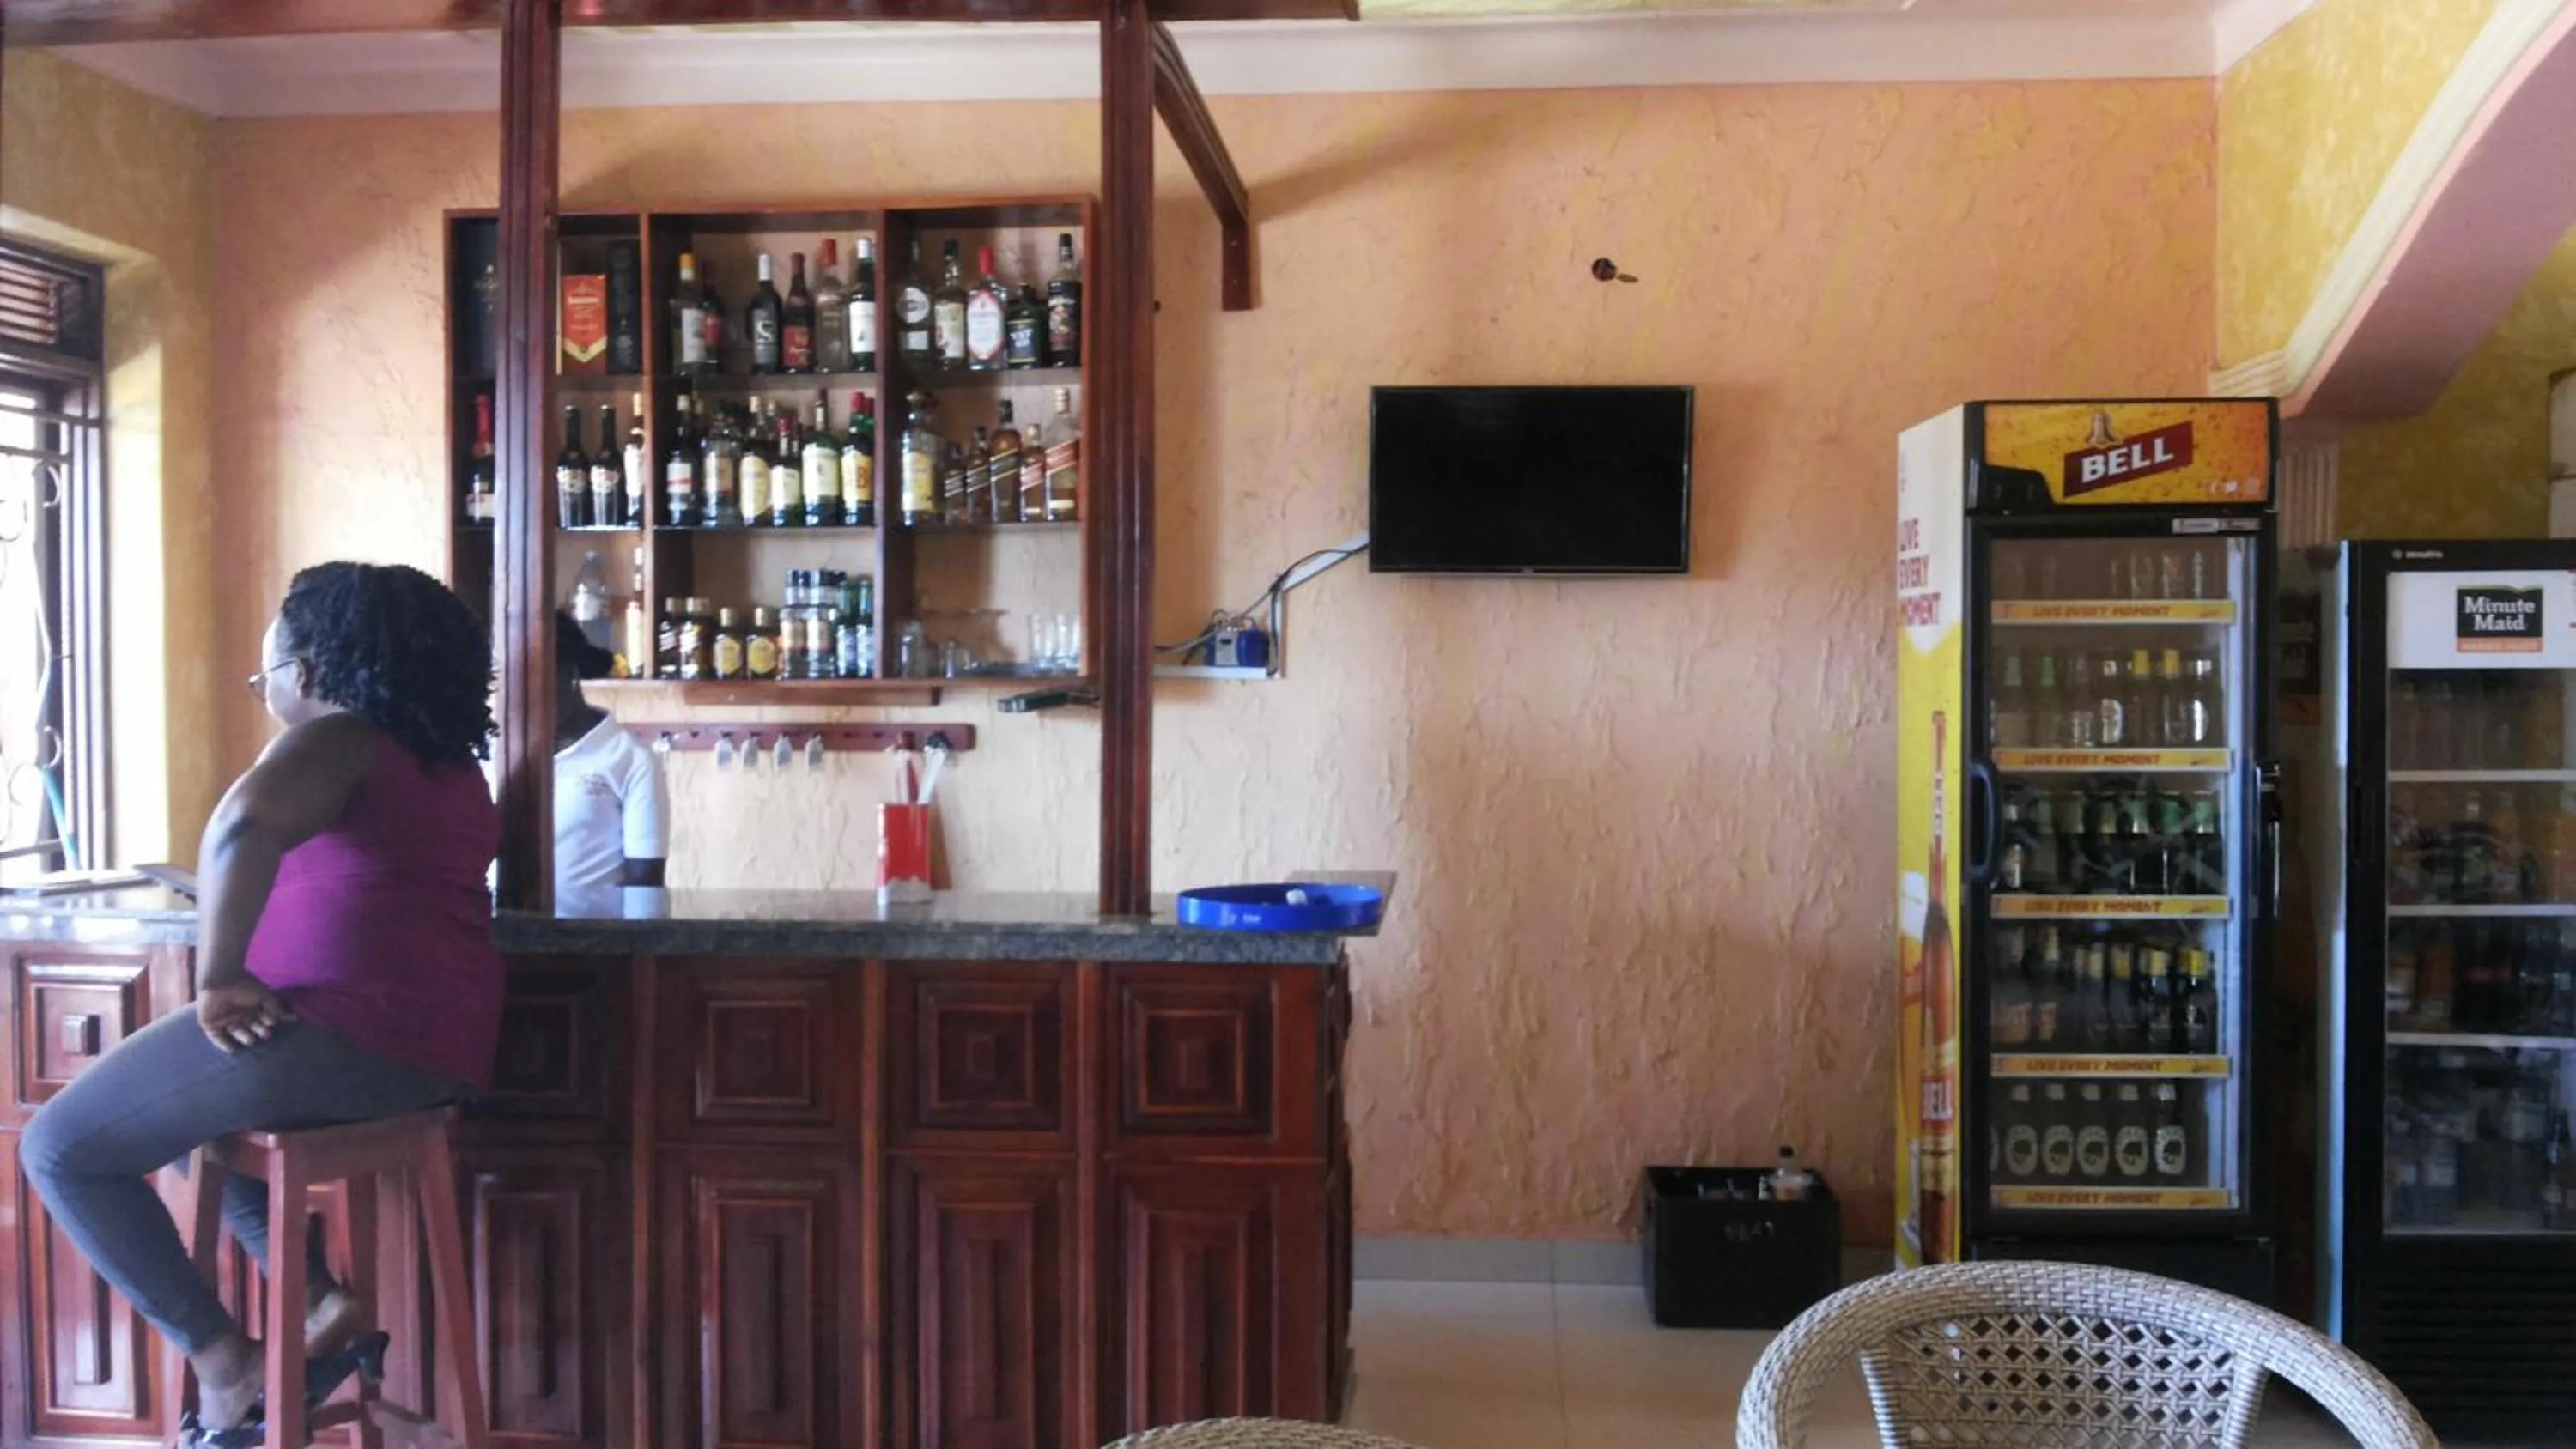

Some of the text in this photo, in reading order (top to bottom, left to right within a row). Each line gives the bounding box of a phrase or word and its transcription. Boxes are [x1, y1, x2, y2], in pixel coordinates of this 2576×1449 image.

[2081, 437, 2174, 483] BELL
[1899, 555, 1929, 590] EVERY
[2111, 605, 2171, 617] MOMENT
[2464, 595, 2536, 614] Minute
[2473, 614, 2527, 632] Maid
[2103, 754, 2161, 765] MOMENT
[2103, 1059, 2163, 1071] MOMENT
